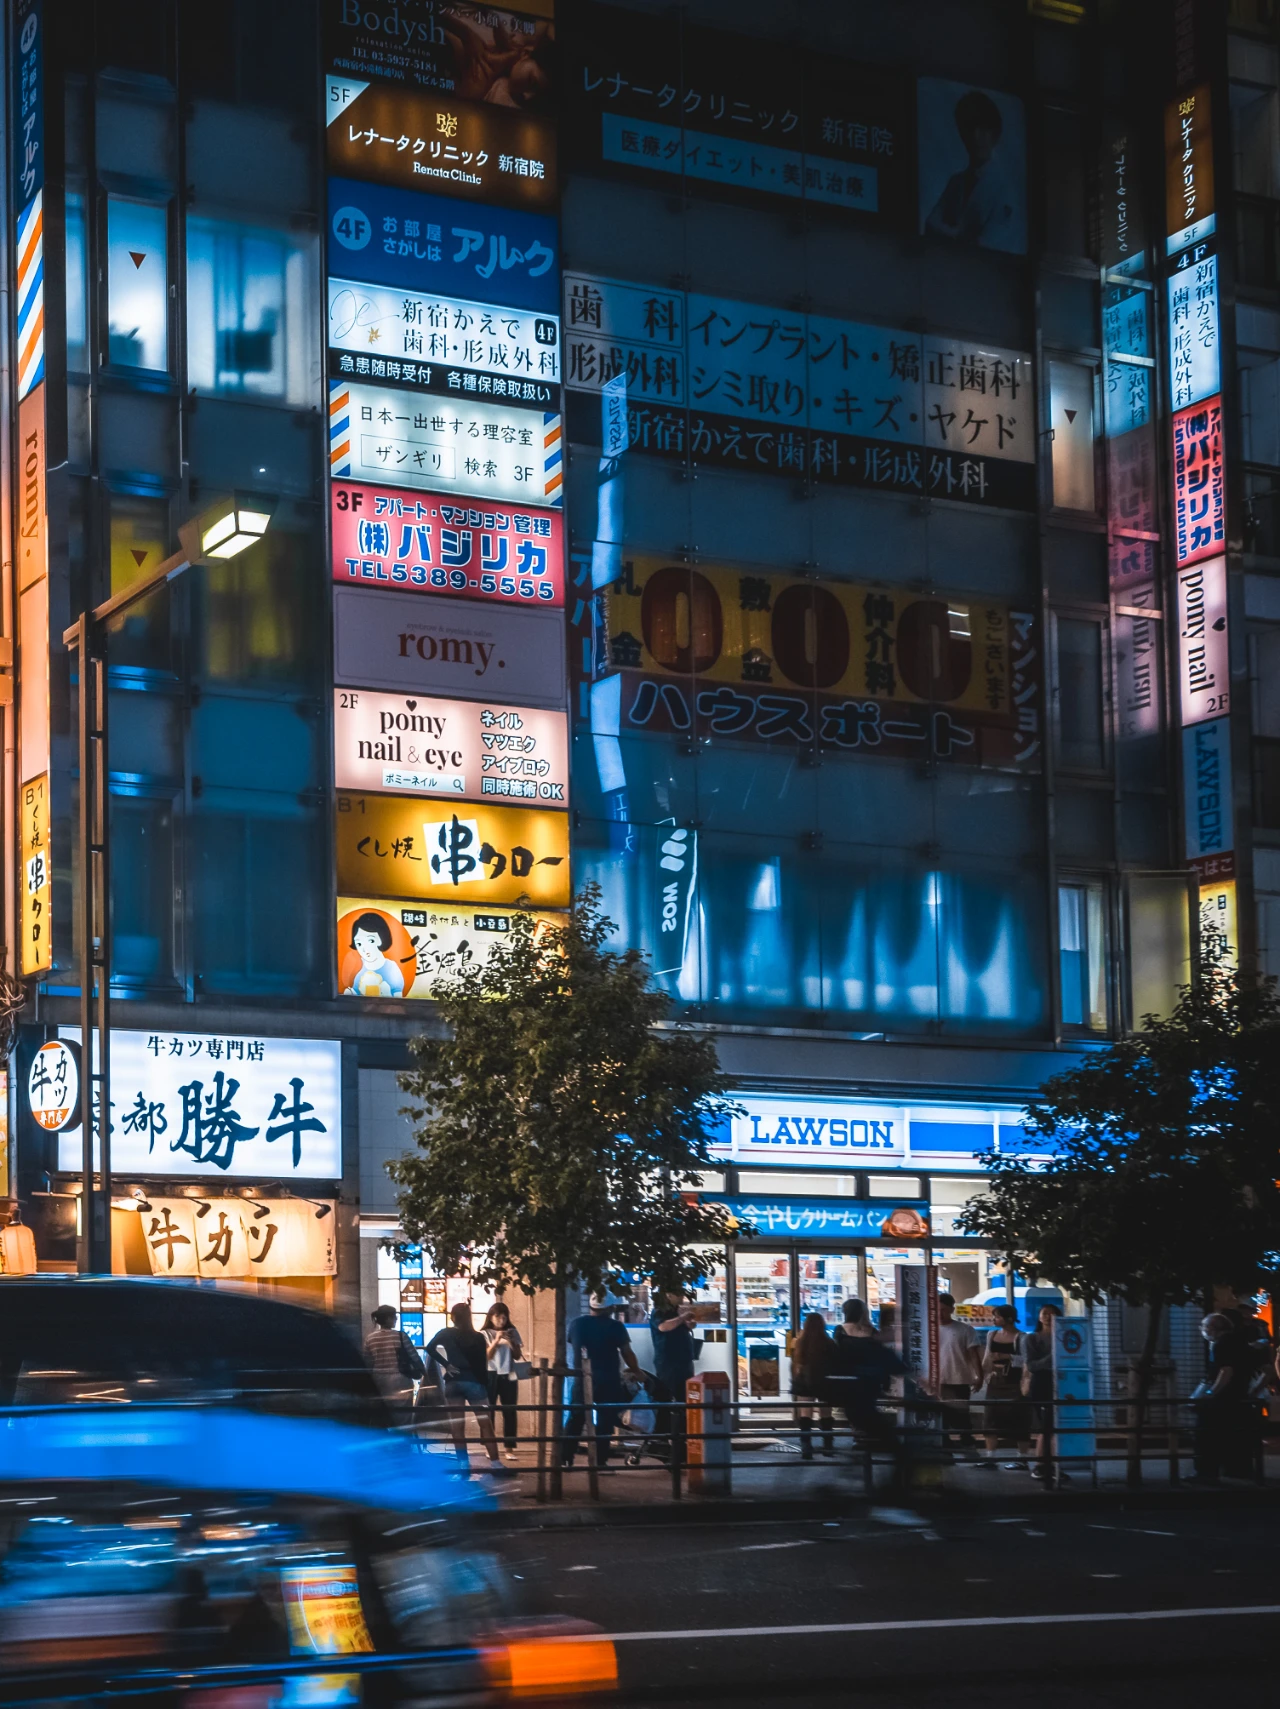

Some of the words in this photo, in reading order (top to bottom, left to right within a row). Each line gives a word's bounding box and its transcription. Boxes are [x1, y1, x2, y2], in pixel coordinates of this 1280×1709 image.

[339, 0, 446, 46] Bodysh
[352, 46, 369, 59] TEL
[330, 86, 351, 103] 5F
[583, 66, 800, 134] レナータクリニック
[821, 115, 894, 157] 新宿院
[348, 125, 489, 167] レナータクリニック
[498, 154, 545, 179] 新宿院
[621, 129, 865, 199] 医療ダイエット・美肌治療
[336, 217, 366, 241] 4F
[382, 216, 442, 243] お部屋
[1184, 226, 1199, 242] 5F
[382, 238, 442, 262] さがしは
[451, 226, 554, 279] アルク
[1177, 243, 1209, 270] 4F
[401, 299, 520, 340] 新宿かえで
[1194, 260, 1216, 348] 新宿かえで
[536, 323, 554, 342] 4F
[1172, 287, 1193, 406] 歯科・形成外科
[403, 328, 559, 377] 歯科・形成外科
[689, 309, 1021, 401] インプラント・矯正歯科
[339, 354, 432, 385] 急患随時受付
[447, 371, 551, 401] 各種保険取扱い
[568, 342, 680, 397] 形成外科
[691, 366, 1018, 450] シミ取り・キズ・ヤケド
[361, 406, 534, 447] 日本一出世する理容室
[376, 445, 442, 471] ザンギリ
[625, 408, 989, 499] 新宿かえで歯科・形成外科
[464, 457, 498, 478] 検索
[514, 465, 535, 483] 3F
[336, 490, 364, 512] 3F
[375, 497, 552, 538] アパート・マンション管理
[1180, 569, 1207, 640] pomy
[1188, 642, 1216, 695] nail
[340, 693, 359, 710] 2F
[1009, 610, 1041, 763] マンション
[480, 710, 523, 730] ネイル
[628, 680, 974, 758] ハウスポート
[1206, 693, 1230, 715] 2F
[379, 709, 447, 740] pomy
[357, 736, 402, 763] nail
[407, 745, 420, 764] &
[424, 752, 463, 771] eye
[481, 733, 536, 753] マツエク
[385, 773, 438, 788] ポミーネイル
[481, 755, 550, 777] アイブロウ
[25, 782, 44, 806] B1
[481, 777, 537, 799] 同時施術
[539, 781, 564, 801] OK
[1195, 725, 1221, 852] LAWSON
[338, 798, 366, 814] B1
[357, 836, 422, 861] くし焼
[147, 1035, 266, 1062] 牛カツ専門店
[750, 1115, 894, 1149] LAWSON
[736, 1203, 887, 1231] 冷やしクリームパン
[147, 1207, 279, 1270] 牛カツ
